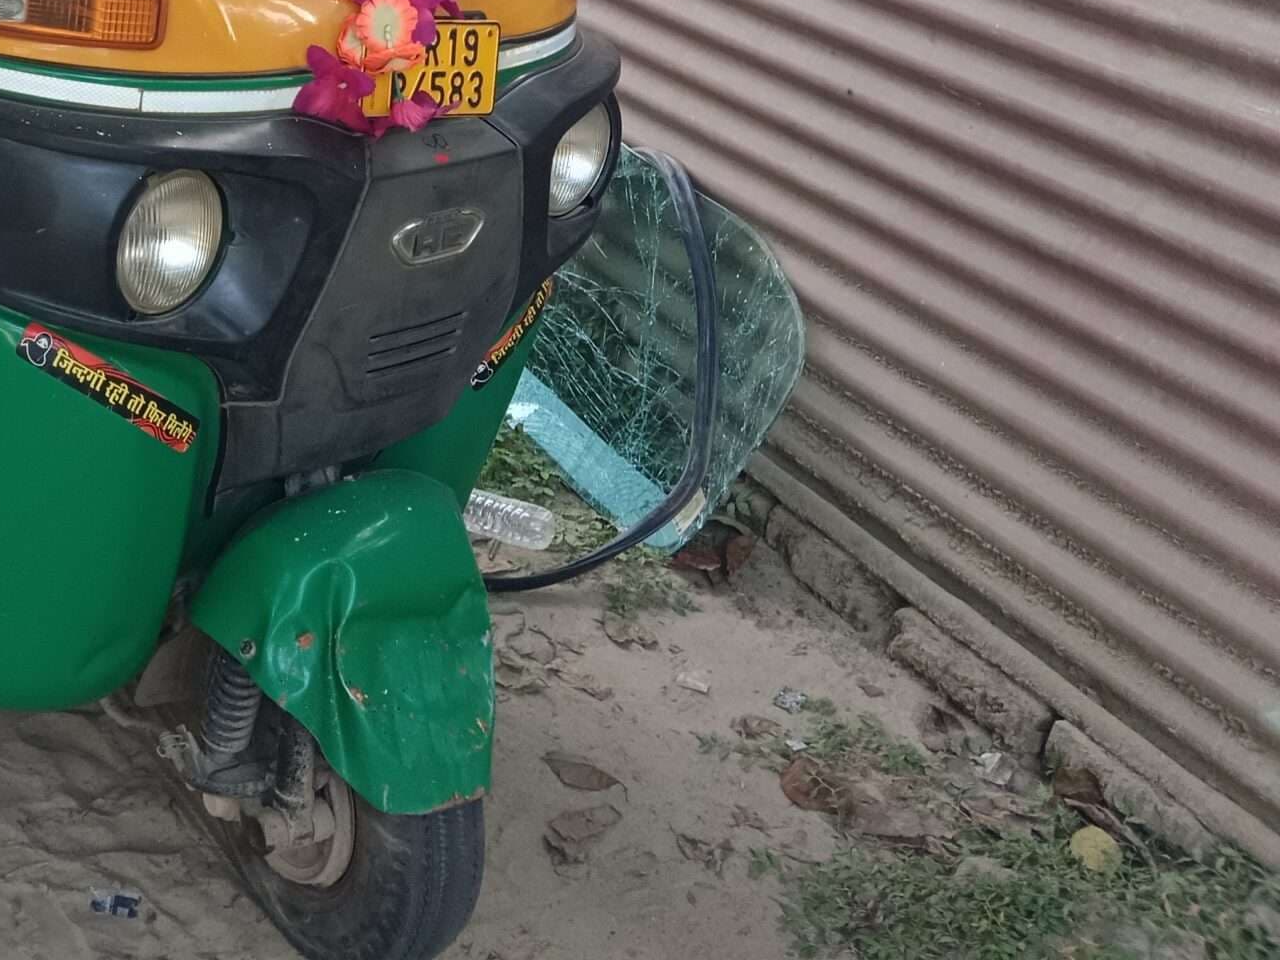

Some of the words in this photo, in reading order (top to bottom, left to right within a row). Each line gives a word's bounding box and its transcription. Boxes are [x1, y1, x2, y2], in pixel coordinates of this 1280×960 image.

[425, 28, 479, 67] R19
[52, 347, 106, 393] जिन्दगी
[105, 380, 129, 406] रही
[127, 393, 144, 415] तो
[144, 401, 166, 427] फिर
[165, 414, 192, 442] मिलेंगे
